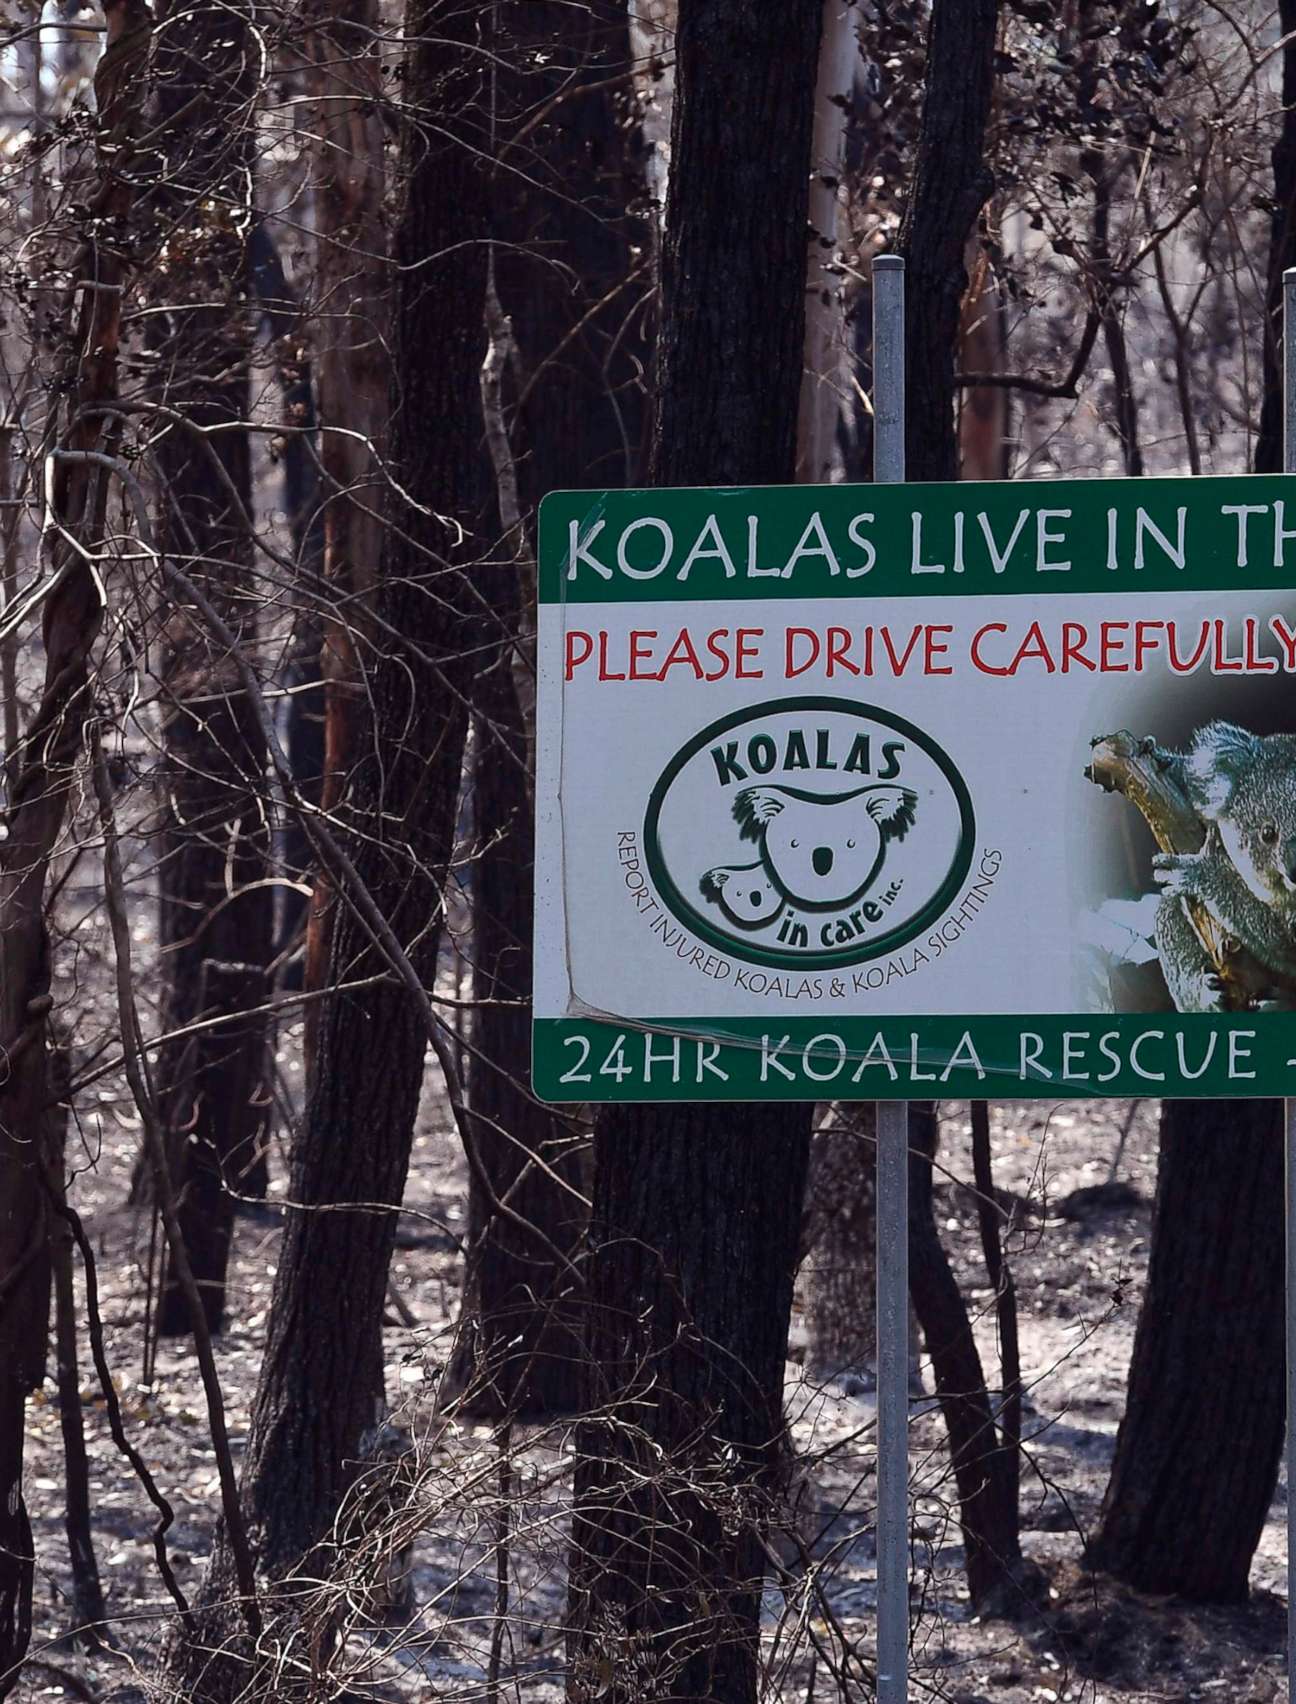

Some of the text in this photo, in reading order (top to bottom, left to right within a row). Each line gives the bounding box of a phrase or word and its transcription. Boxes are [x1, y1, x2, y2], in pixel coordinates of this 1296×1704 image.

[567, 512, 876, 581] KOALAS
[910, 508, 1072, 574] LIVE
[1107, 506, 1187, 570] IN
[564, 627, 764, 682] PLEASE
[784, 624, 954, 678] DRIVE
[710, 729, 906, 787] KOALAS
[617, 831, 1002, 1000] REPORT INJURED KOALAS & KOALA SIGHTINGS
[776, 877, 904, 947] in care inc.
[558, 1034, 729, 1083] 24HR
[760, 1030, 986, 1083] KOALA
[1018, 1029, 1257, 1082] RESCUE
